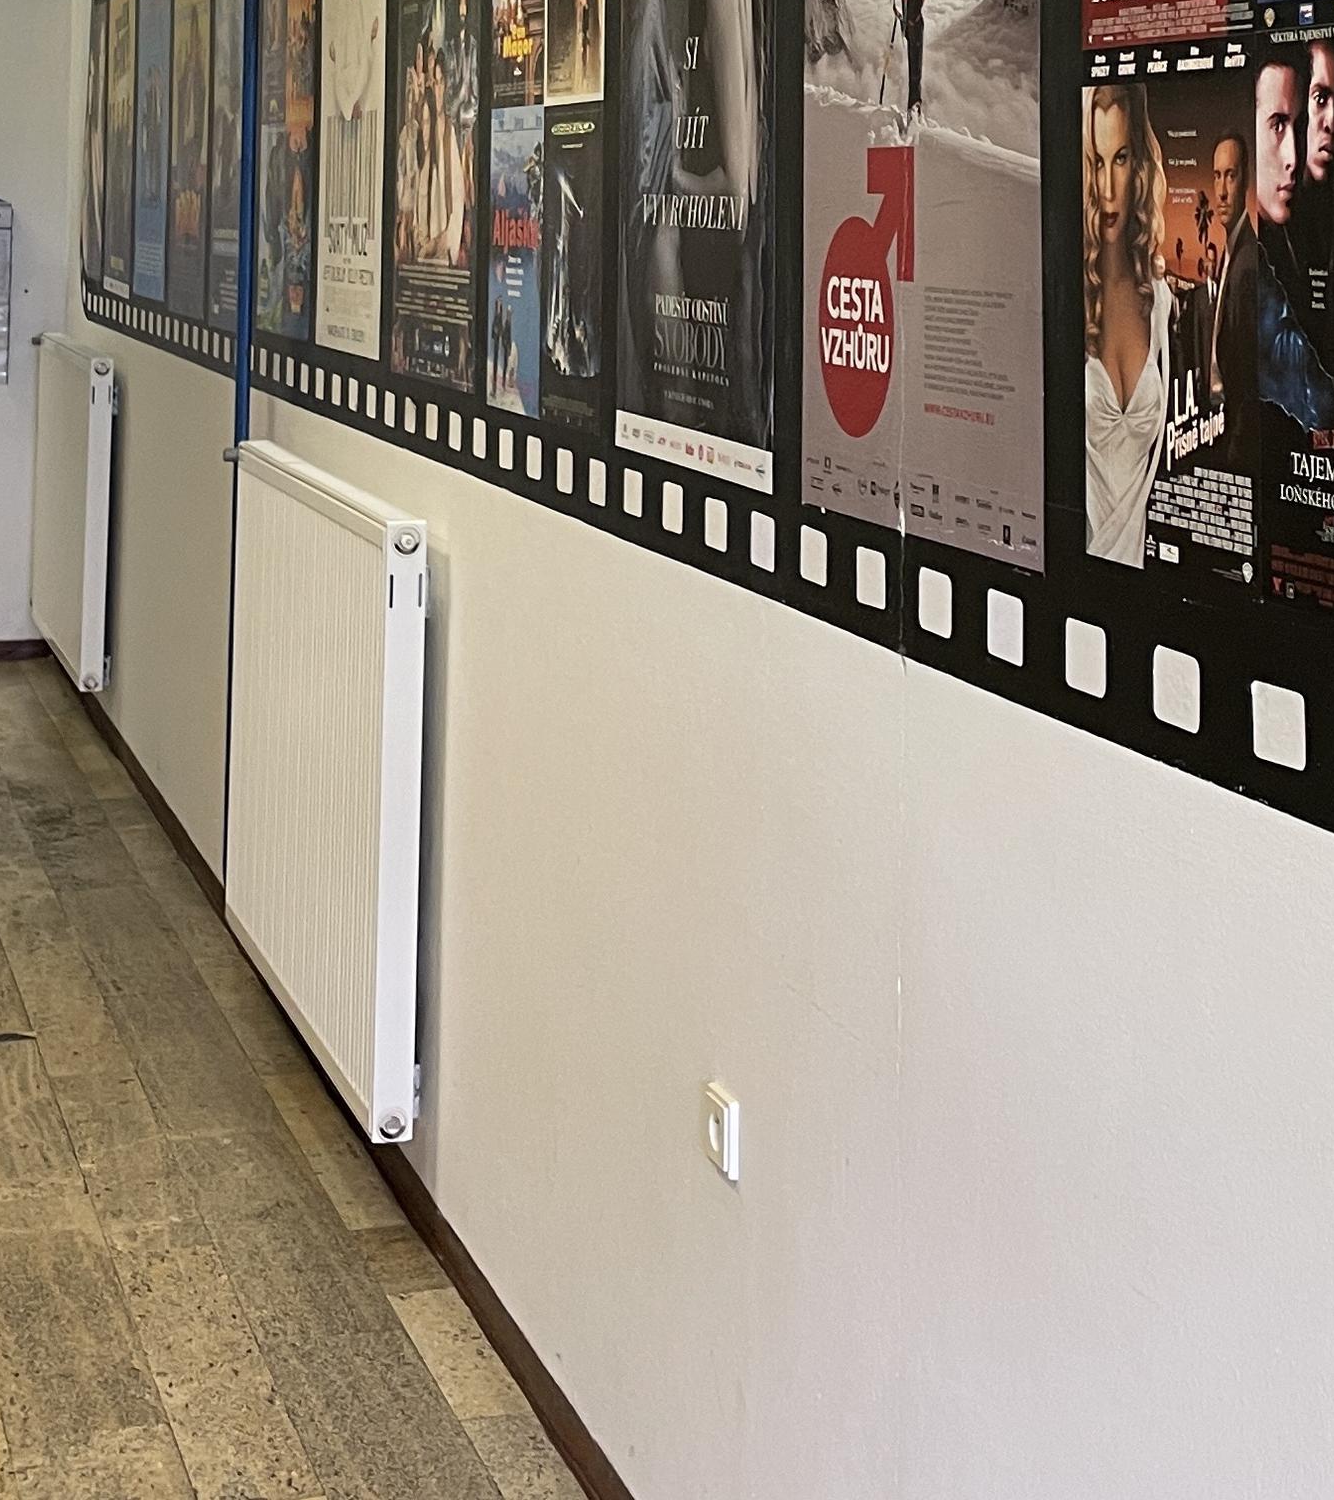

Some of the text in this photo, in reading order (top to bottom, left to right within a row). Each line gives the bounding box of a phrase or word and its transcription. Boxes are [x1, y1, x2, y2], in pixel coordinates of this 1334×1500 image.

[683, 36, 699, 71] SI
[675, 106, 709, 149] UJÍT
[827, 275, 885, 324] CESTA
[821, 322, 890, 374] VZHŮRU
[1174, 369, 1199, 426] L.A.
[1200, 402, 1225, 447] tajné
